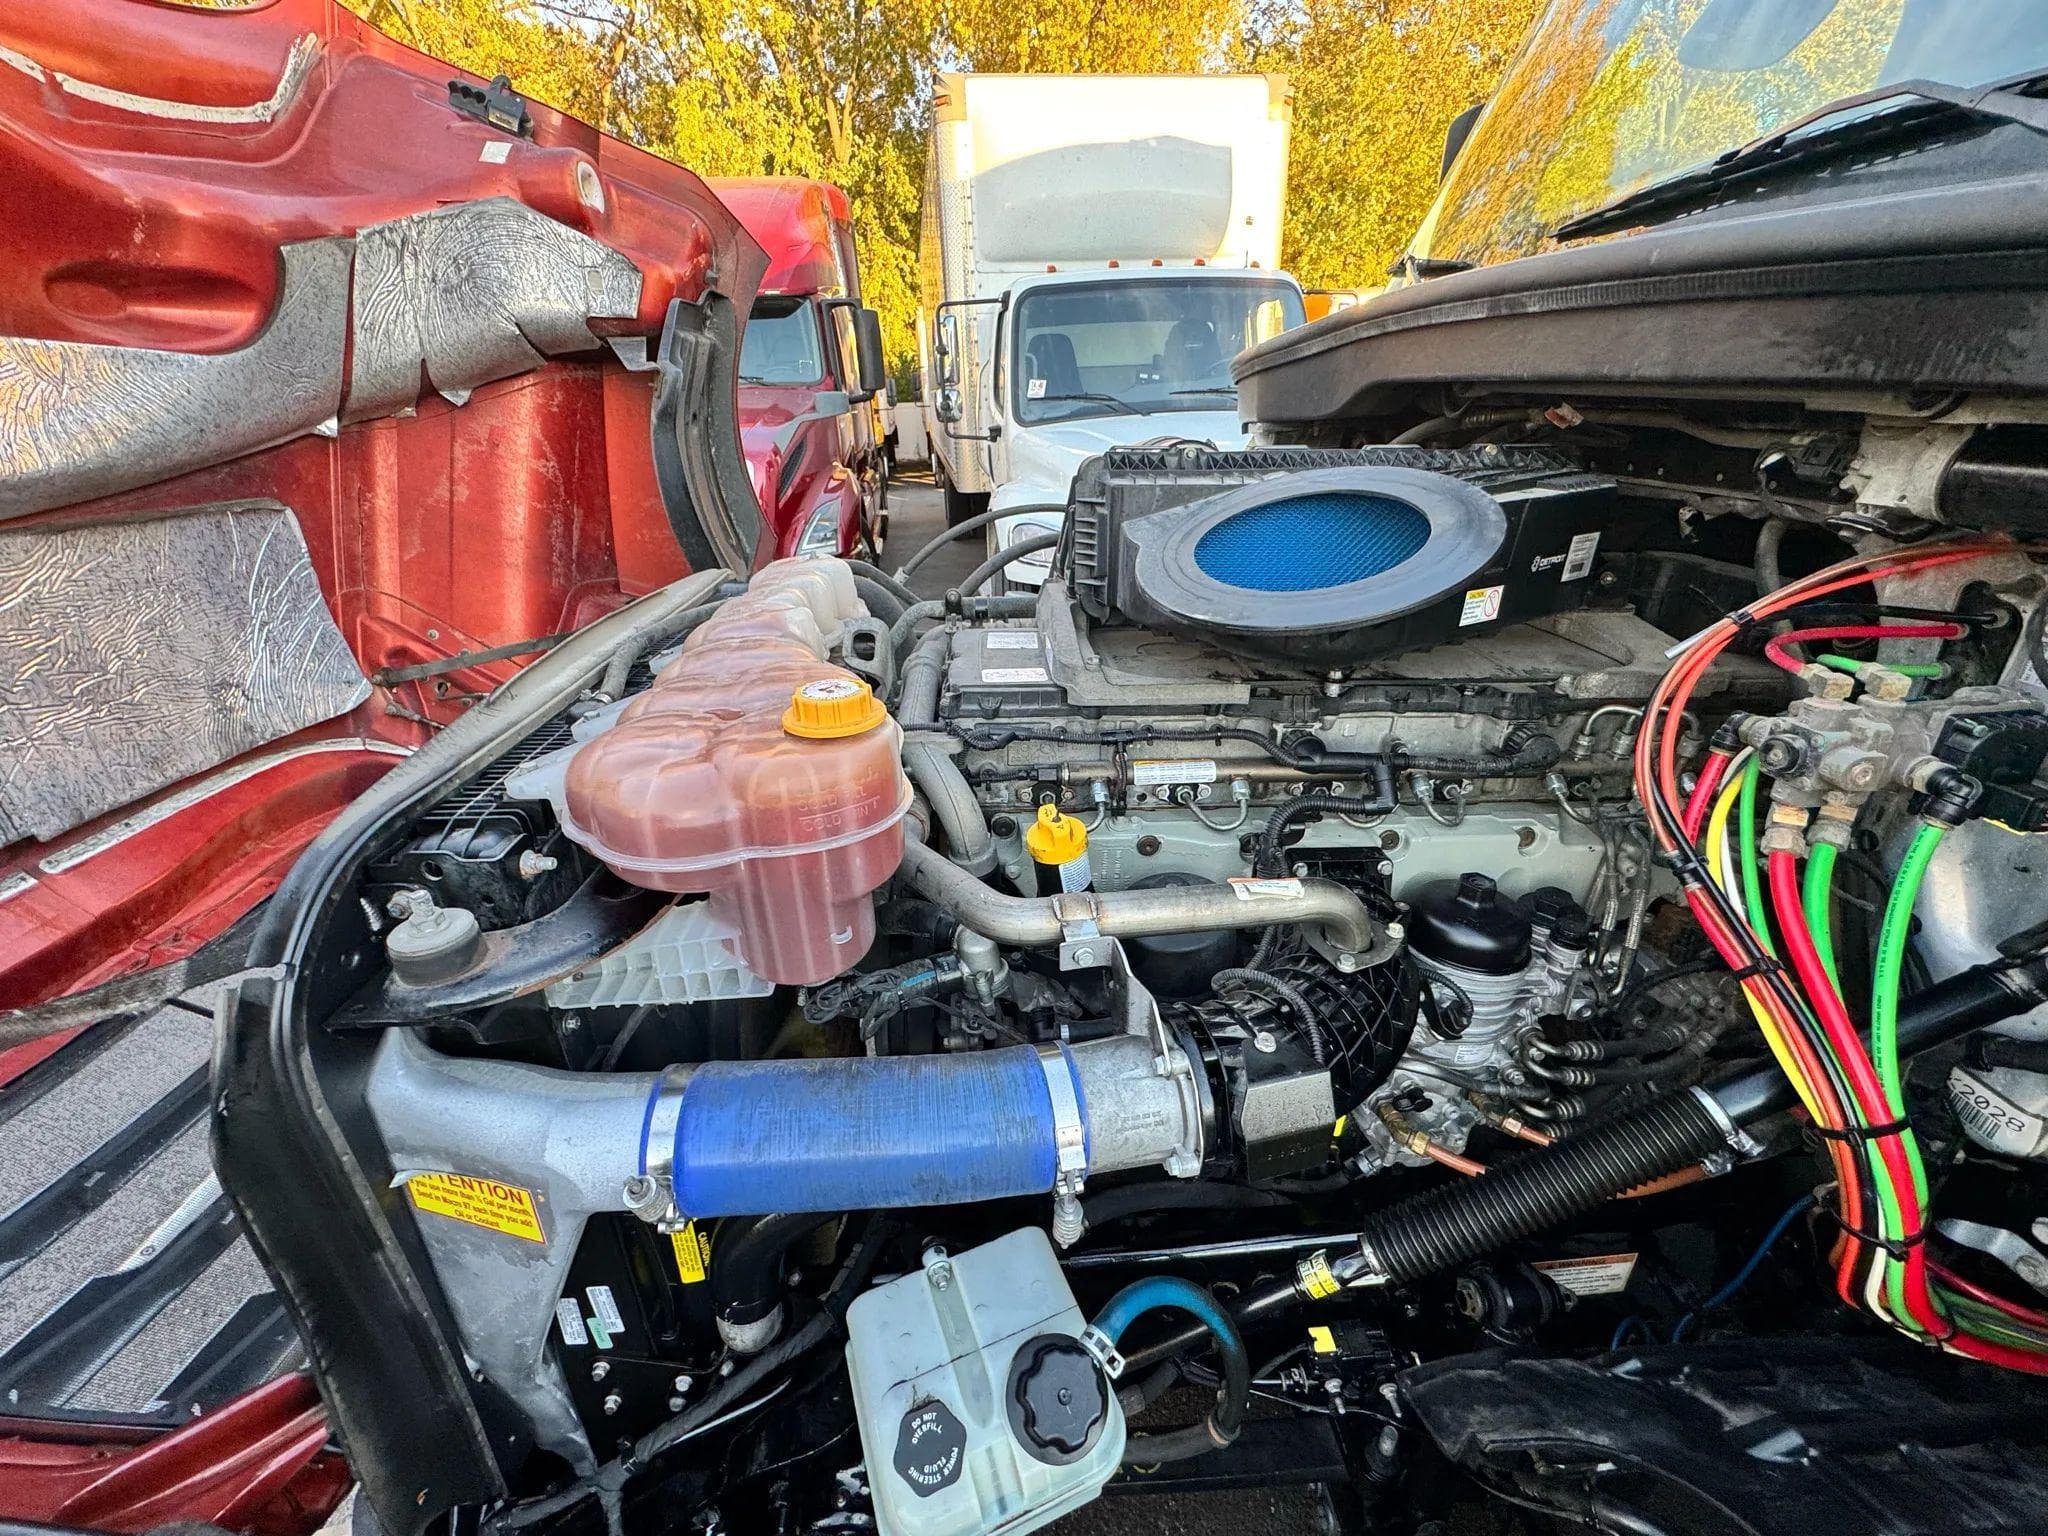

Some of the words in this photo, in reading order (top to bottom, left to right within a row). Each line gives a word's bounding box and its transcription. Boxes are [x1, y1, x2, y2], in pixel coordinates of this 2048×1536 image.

[422, 1174, 525, 1206] TENTION
[911, 1417, 921, 1429] DO
[922, 1412, 937, 1422] NOT
[911, 1422, 942, 1445] OVERFILL
[924, 1456, 946, 1473] FLUID
[943, 1447, 958, 1476] POWER
[908, 1466, 941, 1484] STEERING
